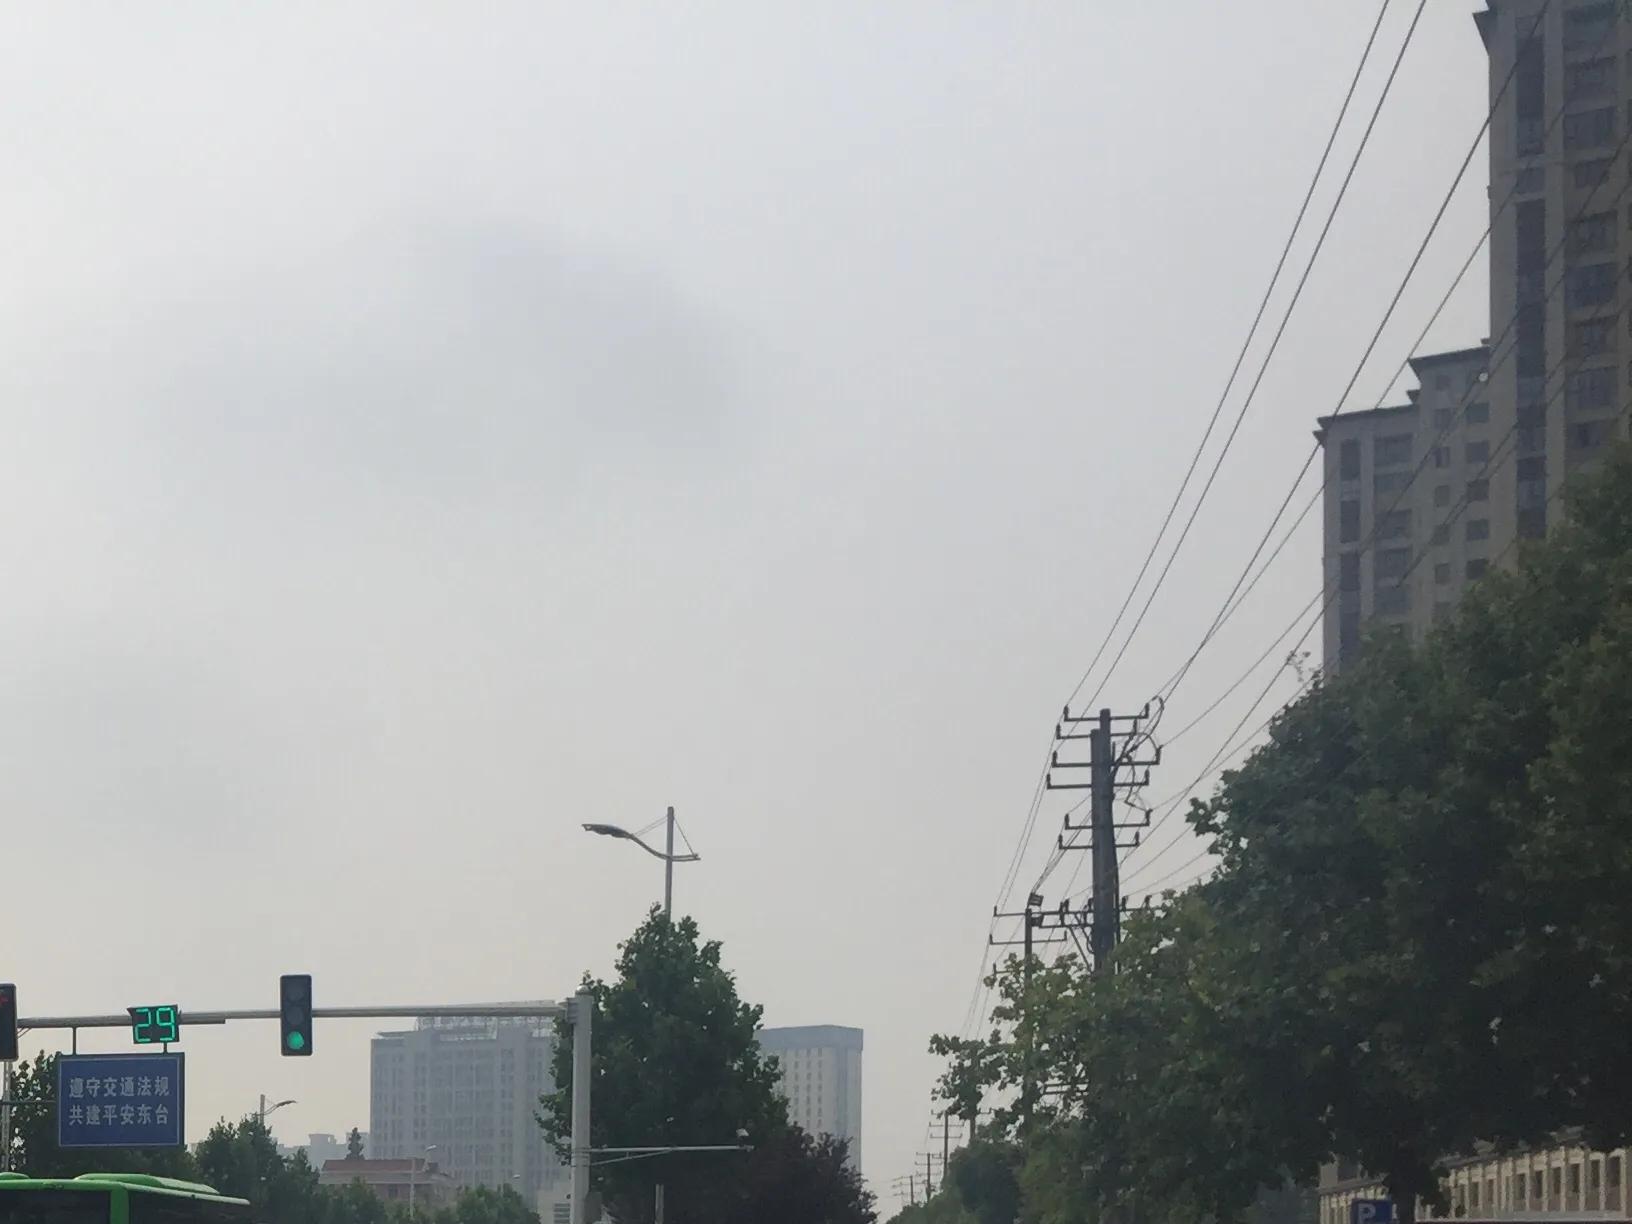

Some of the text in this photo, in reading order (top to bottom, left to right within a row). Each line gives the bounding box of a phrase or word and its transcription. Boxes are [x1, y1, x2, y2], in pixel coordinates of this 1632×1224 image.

[135, 1007, 175, 1042] 29
[69, 1076, 170, 1098] 遵守交通法规
[69, 1104, 169, 1126] 共建平安东台
